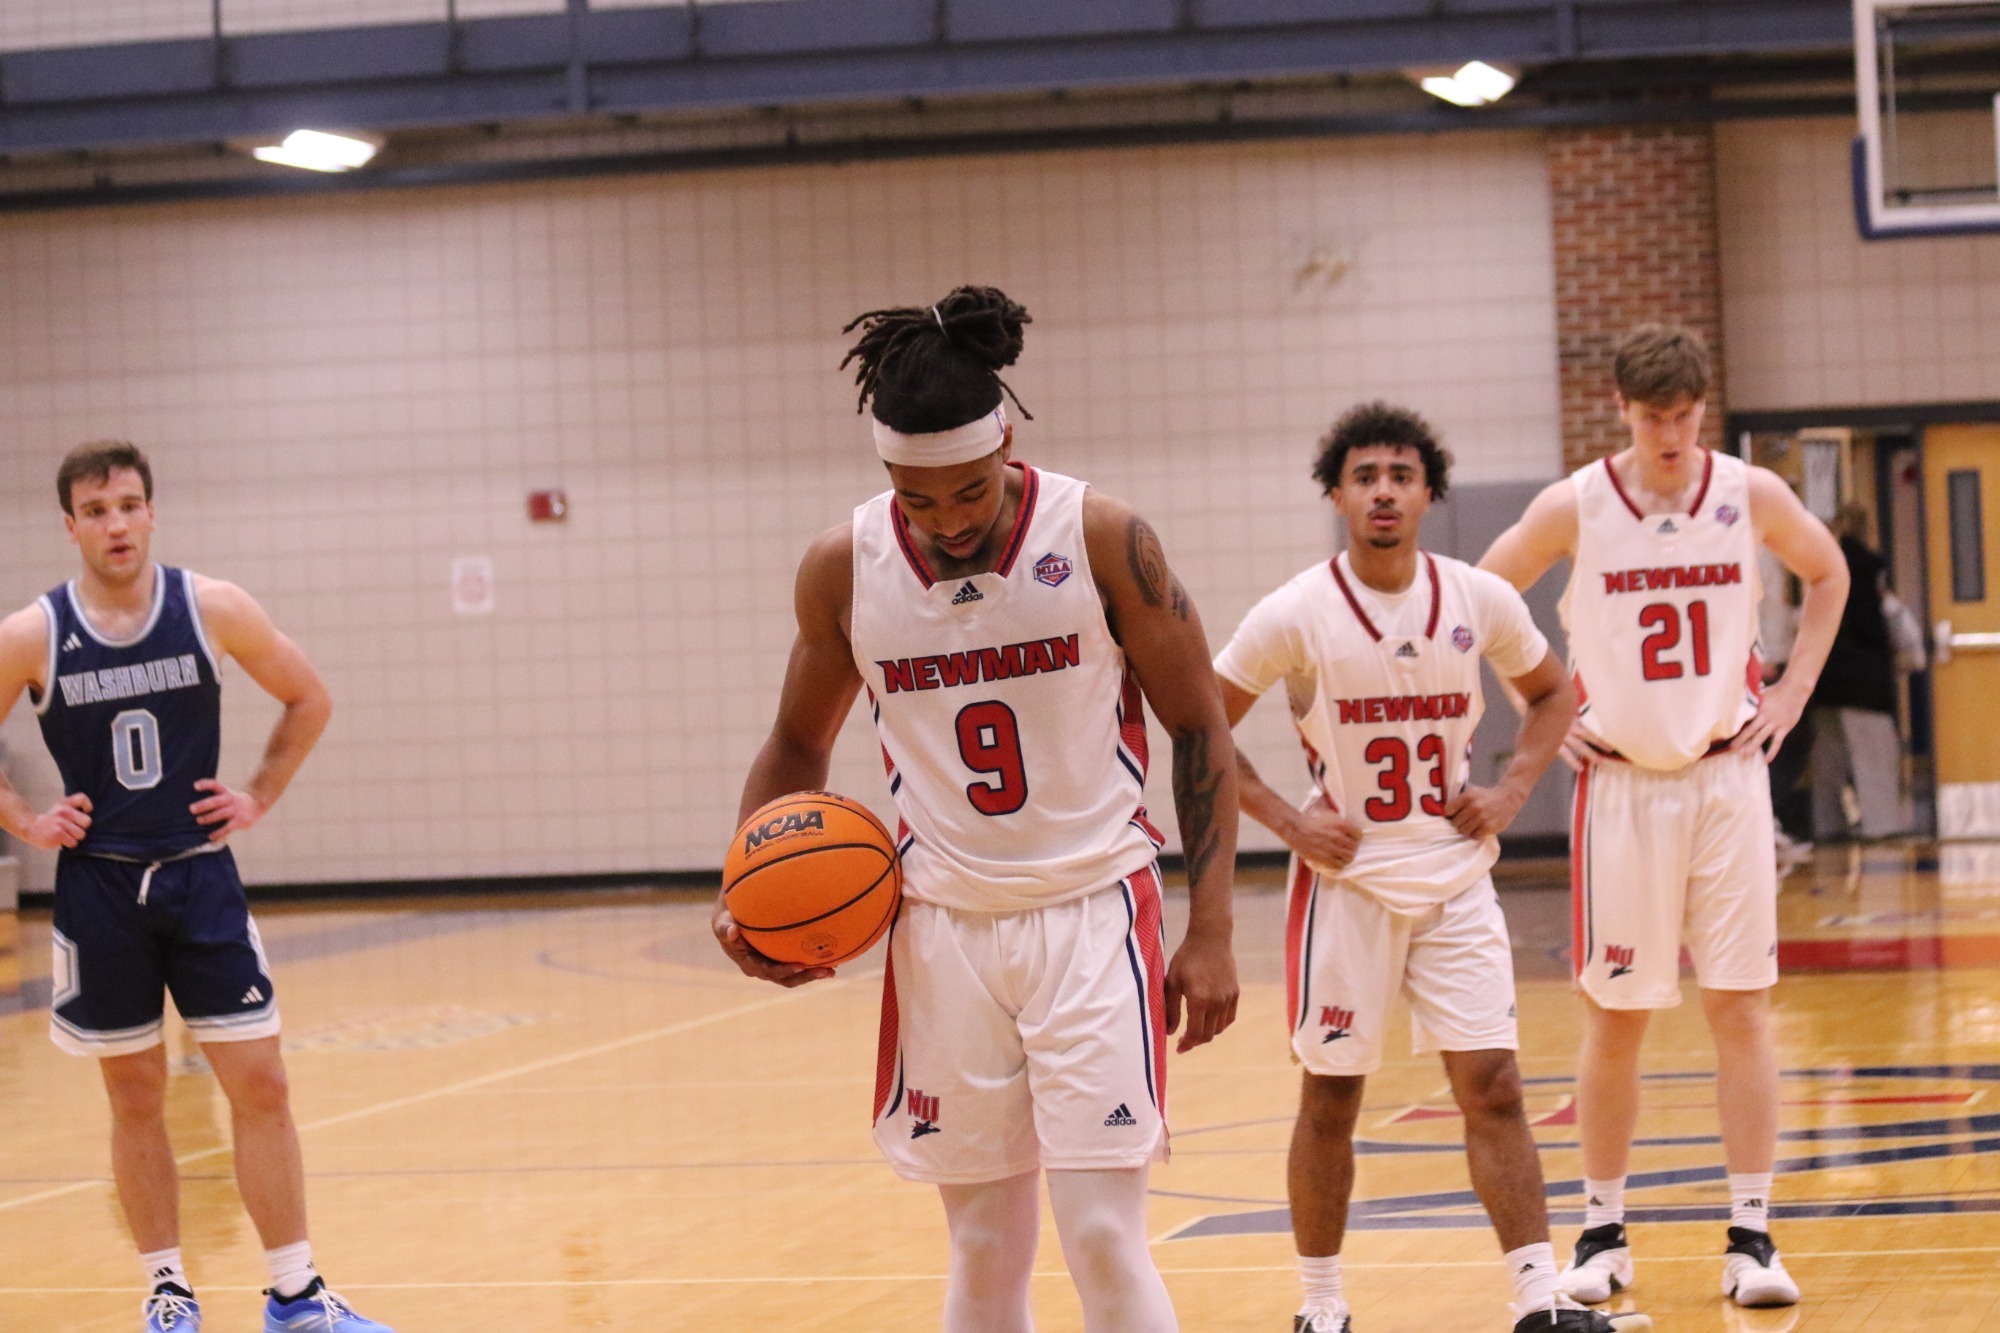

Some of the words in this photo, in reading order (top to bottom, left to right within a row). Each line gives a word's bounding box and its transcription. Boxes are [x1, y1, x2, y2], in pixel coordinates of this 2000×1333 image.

[1035, 562, 1071, 578] MIAA
[1600, 562, 1742, 594] NEWMAN
[951, 592, 984, 605] adidas
[1639, 599, 1711, 681] 21
[875, 633, 1080, 693] NEWMAN
[58, 654, 200, 707] WASHBURN
[1334, 692, 1471, 724] NEWMAN
[111, 708, 163, 790] 0
[955, 700, 1028, 816] 9
[1365, 733, 1448, 822] 33
[745, 810, 824, 855] NCAA
[745, 841, 774, 861] OCIAL
[1604, 944, 1634, 966] NU
[1320, 1005, 1354, 1030] NU
[906, 1088, 940, 1123] NU
[1104, 1116, 1137, 1126] adidas
